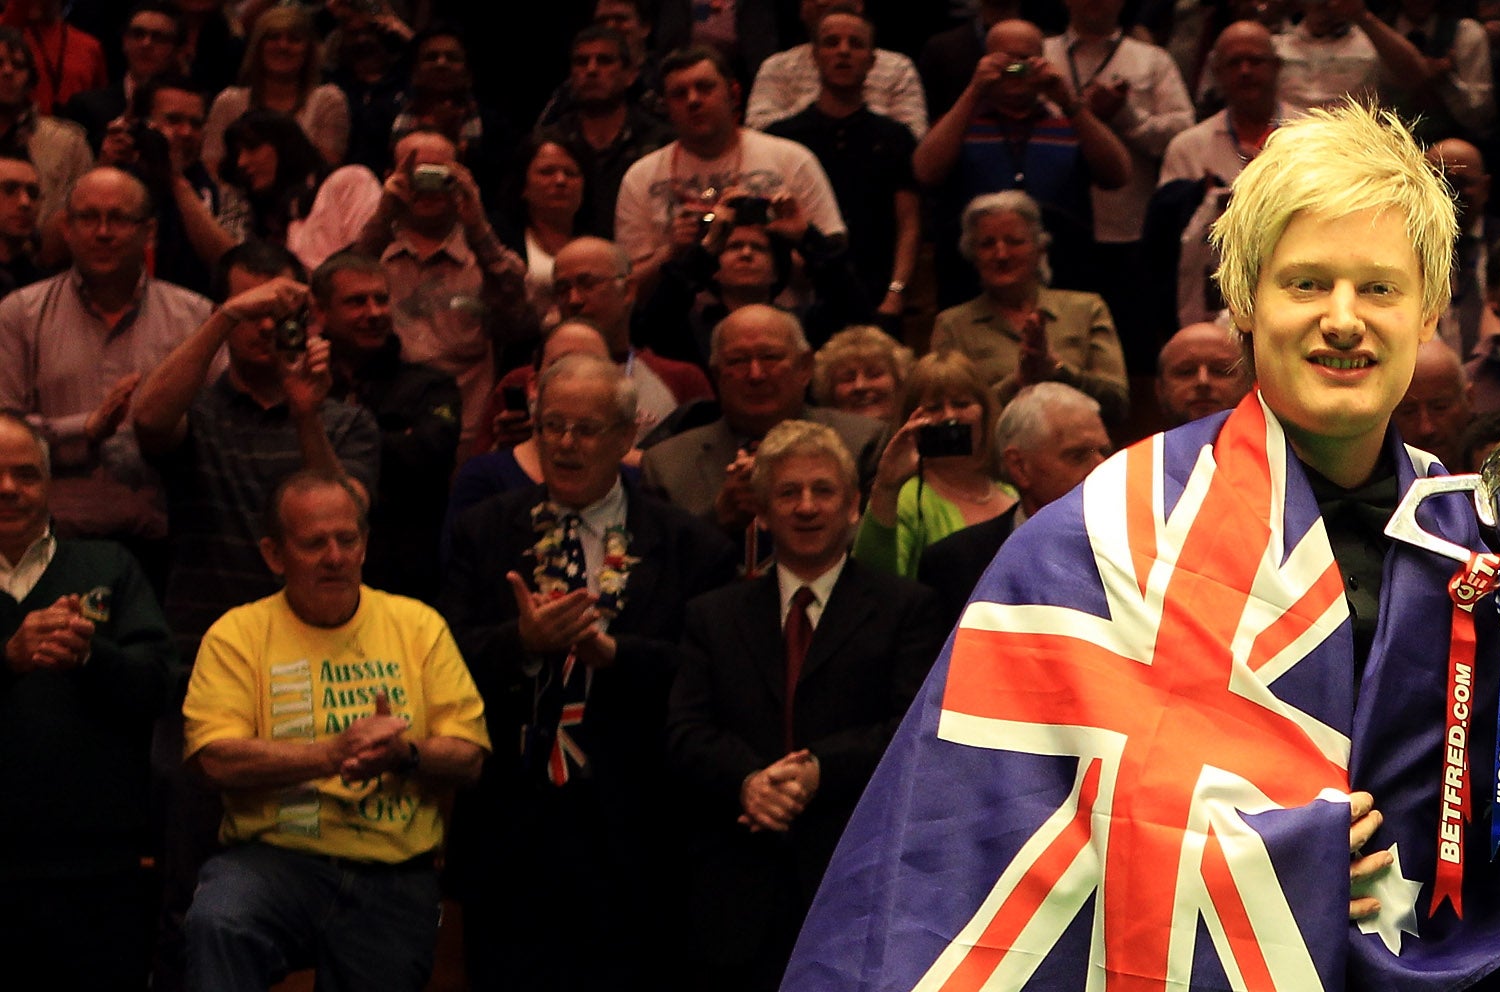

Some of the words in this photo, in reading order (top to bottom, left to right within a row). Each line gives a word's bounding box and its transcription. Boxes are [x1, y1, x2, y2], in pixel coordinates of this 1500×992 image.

[320, 659, 402, 683] Aussie
[322, 683, 407, 710] Aussie
[1440, 662, 1472, 864] BETFRED.COM
